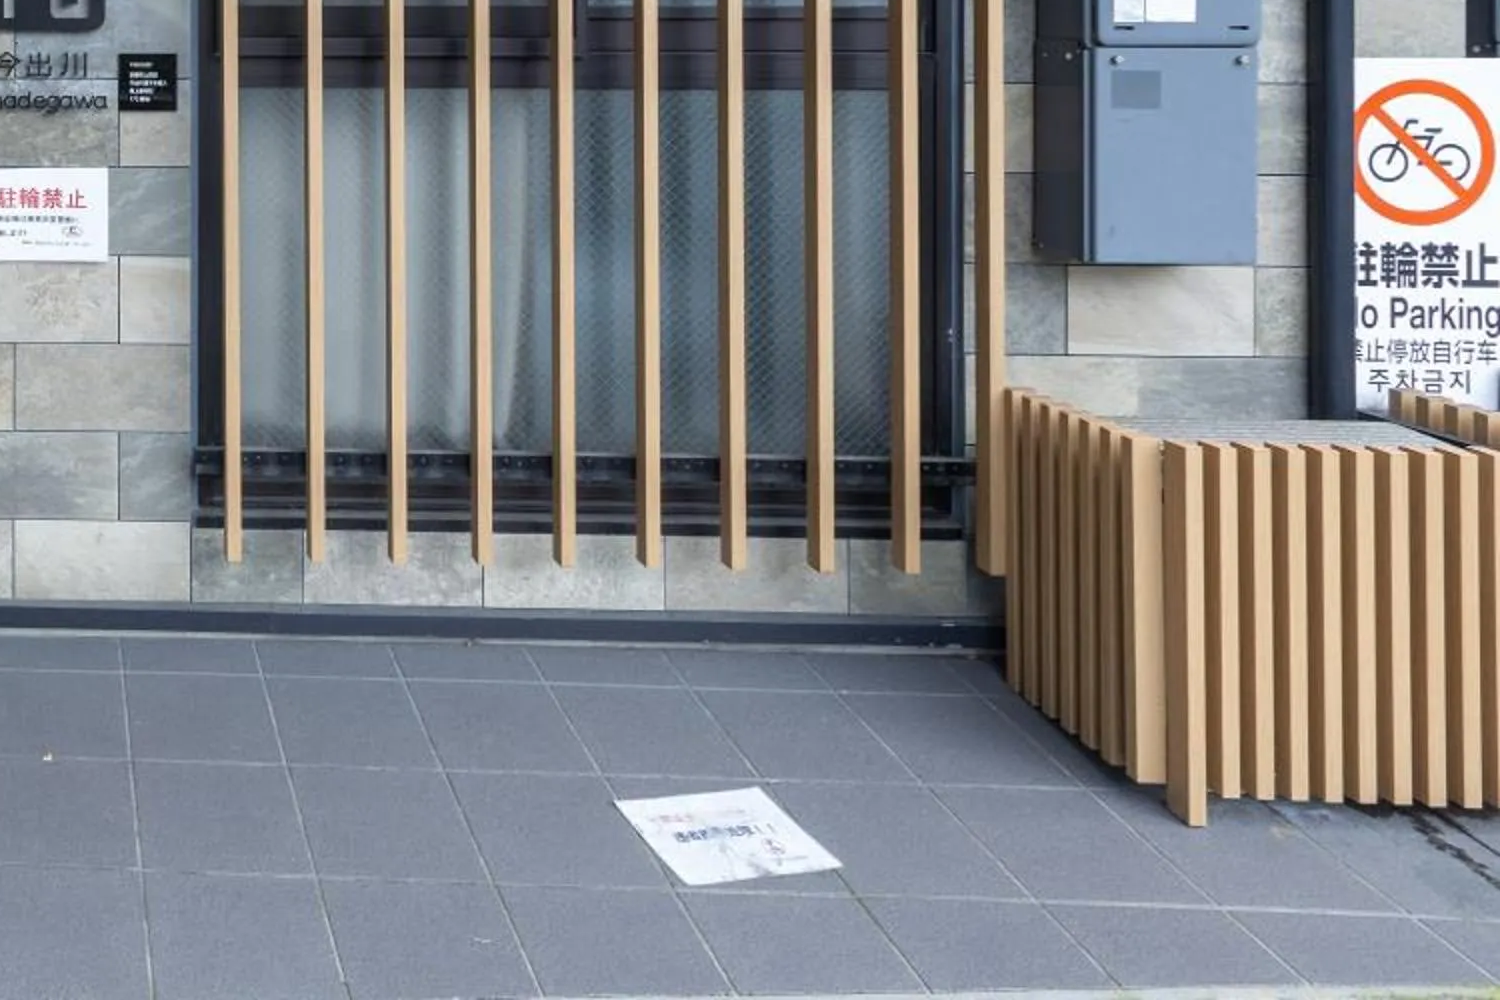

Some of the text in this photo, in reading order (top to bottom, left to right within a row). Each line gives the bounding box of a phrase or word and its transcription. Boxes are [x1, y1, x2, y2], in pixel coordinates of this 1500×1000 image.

[1355, 297, 1500, 338] o Parking
[1368, 368, 1471, 394] 주차금지
